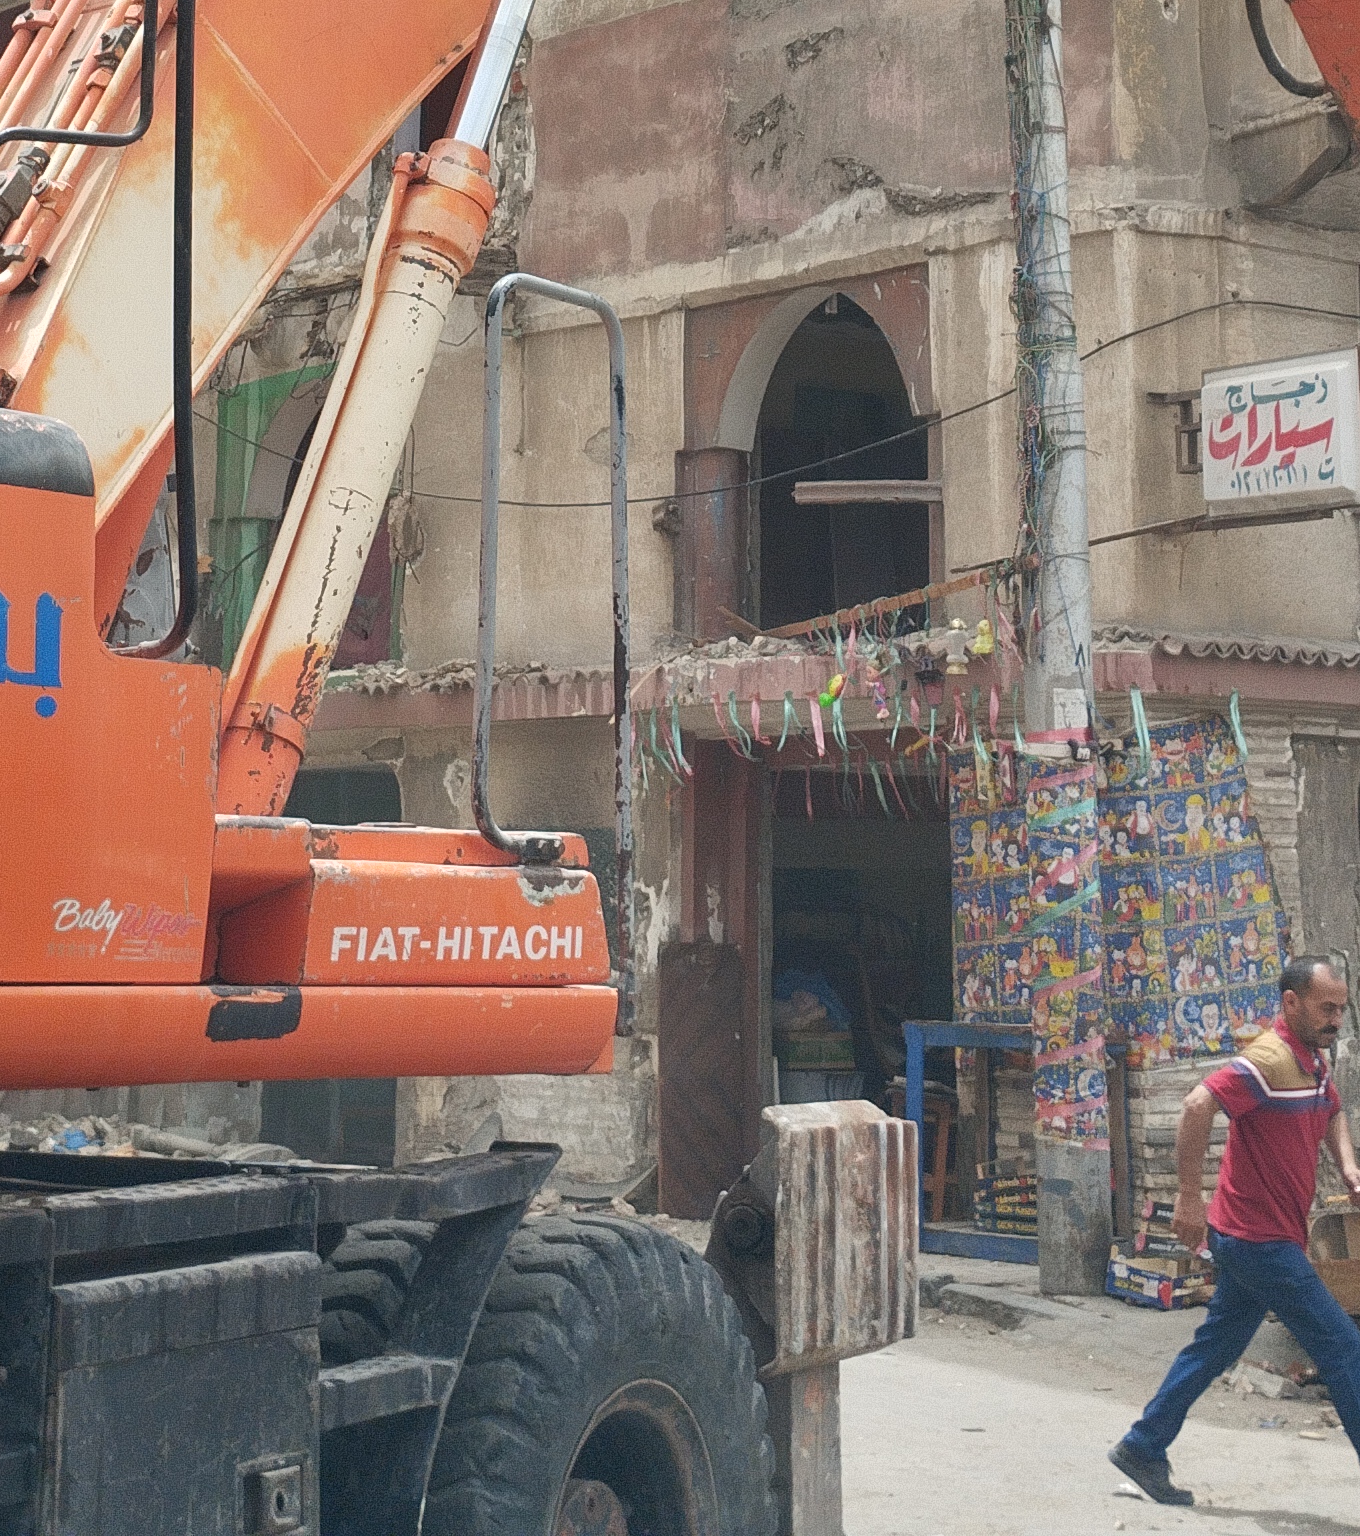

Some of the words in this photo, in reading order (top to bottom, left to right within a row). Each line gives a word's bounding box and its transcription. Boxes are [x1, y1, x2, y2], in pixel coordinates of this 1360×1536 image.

[1225, 372, 1329, 415] زجاج
[1208, 399, 1335, 471] سيارات
[52, 896, 125, 955] Baby
[329, 924, 584, 963] FIAT-HITACHI
